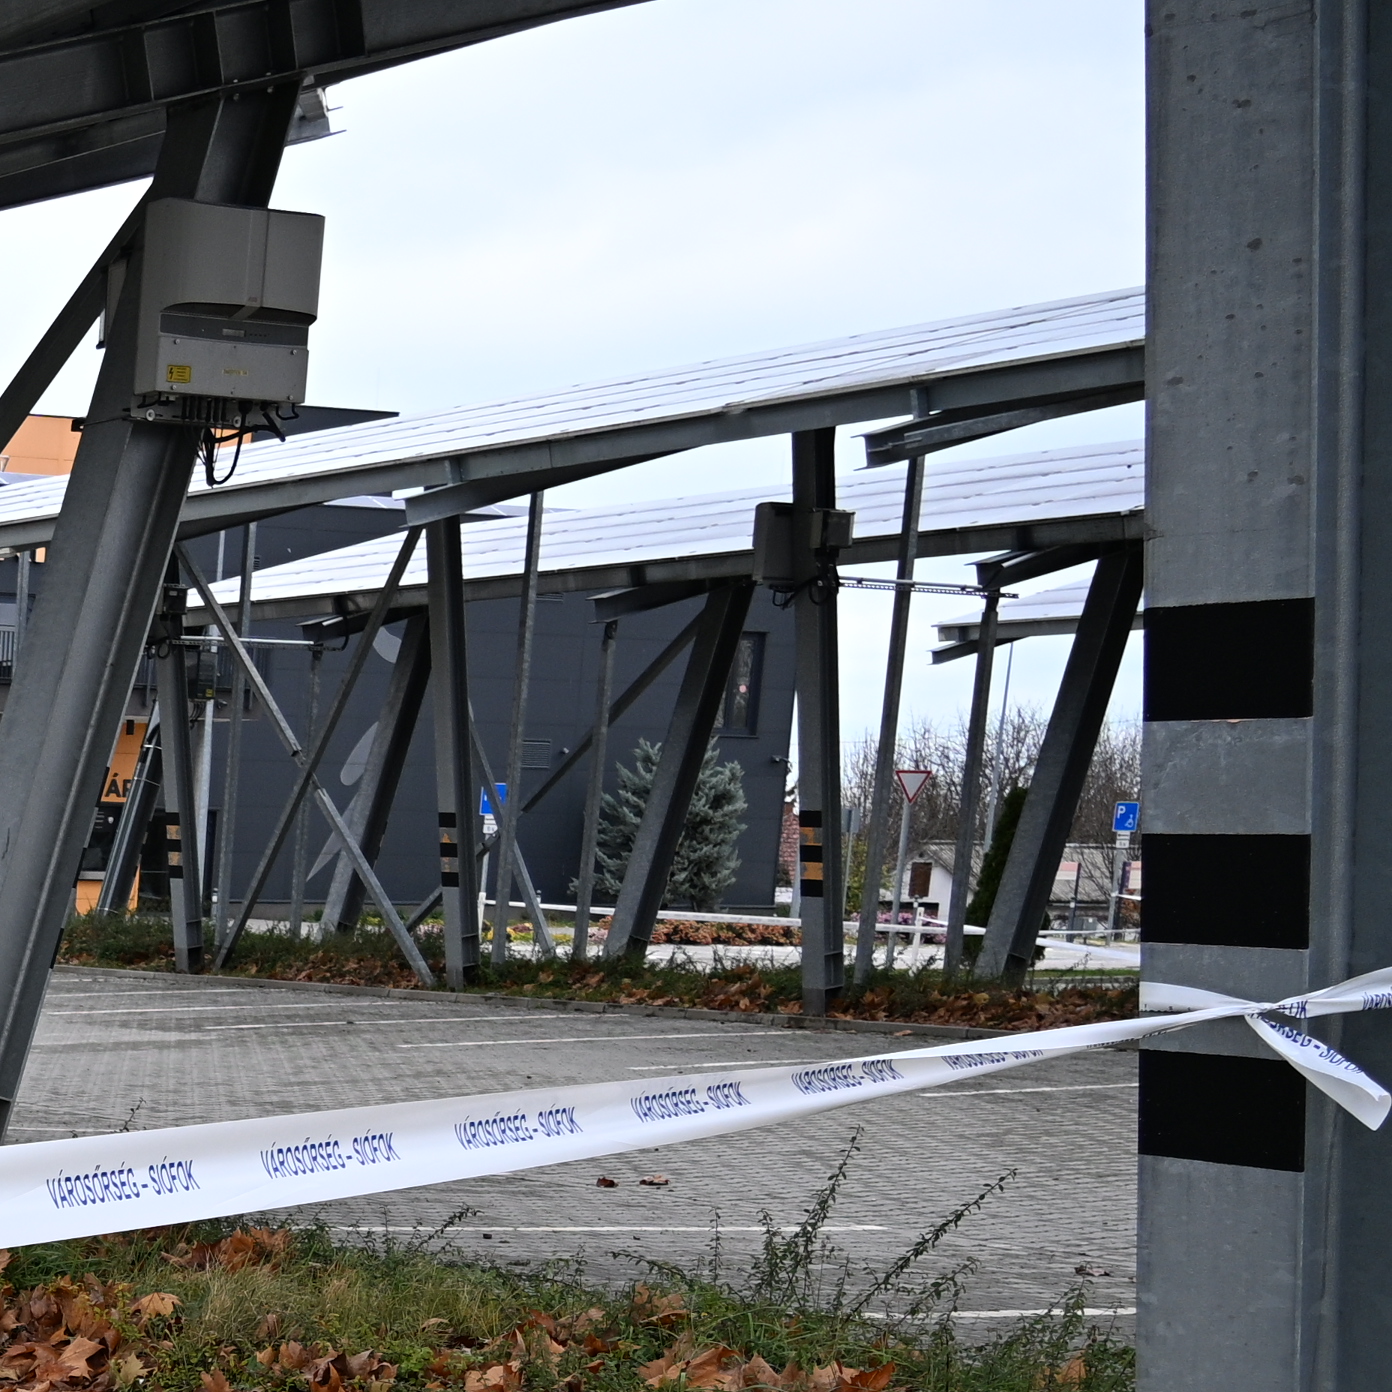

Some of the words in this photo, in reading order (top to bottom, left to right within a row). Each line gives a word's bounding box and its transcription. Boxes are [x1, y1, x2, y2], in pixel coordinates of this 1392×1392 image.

[454, 1108, 534, 1150] VÁROSŐRSÉG
[538, 1103, 583, 1138] SIÓFOK
[260, 1134, 346, 1179] VÁROSŐRSÉG
[353, 1128, 401, 1166] SIÓFOK
[46, 1161, 140, 1209] VÁROSŐRSÉG
[148, 1155, 200, 1196] SIÓFOK
